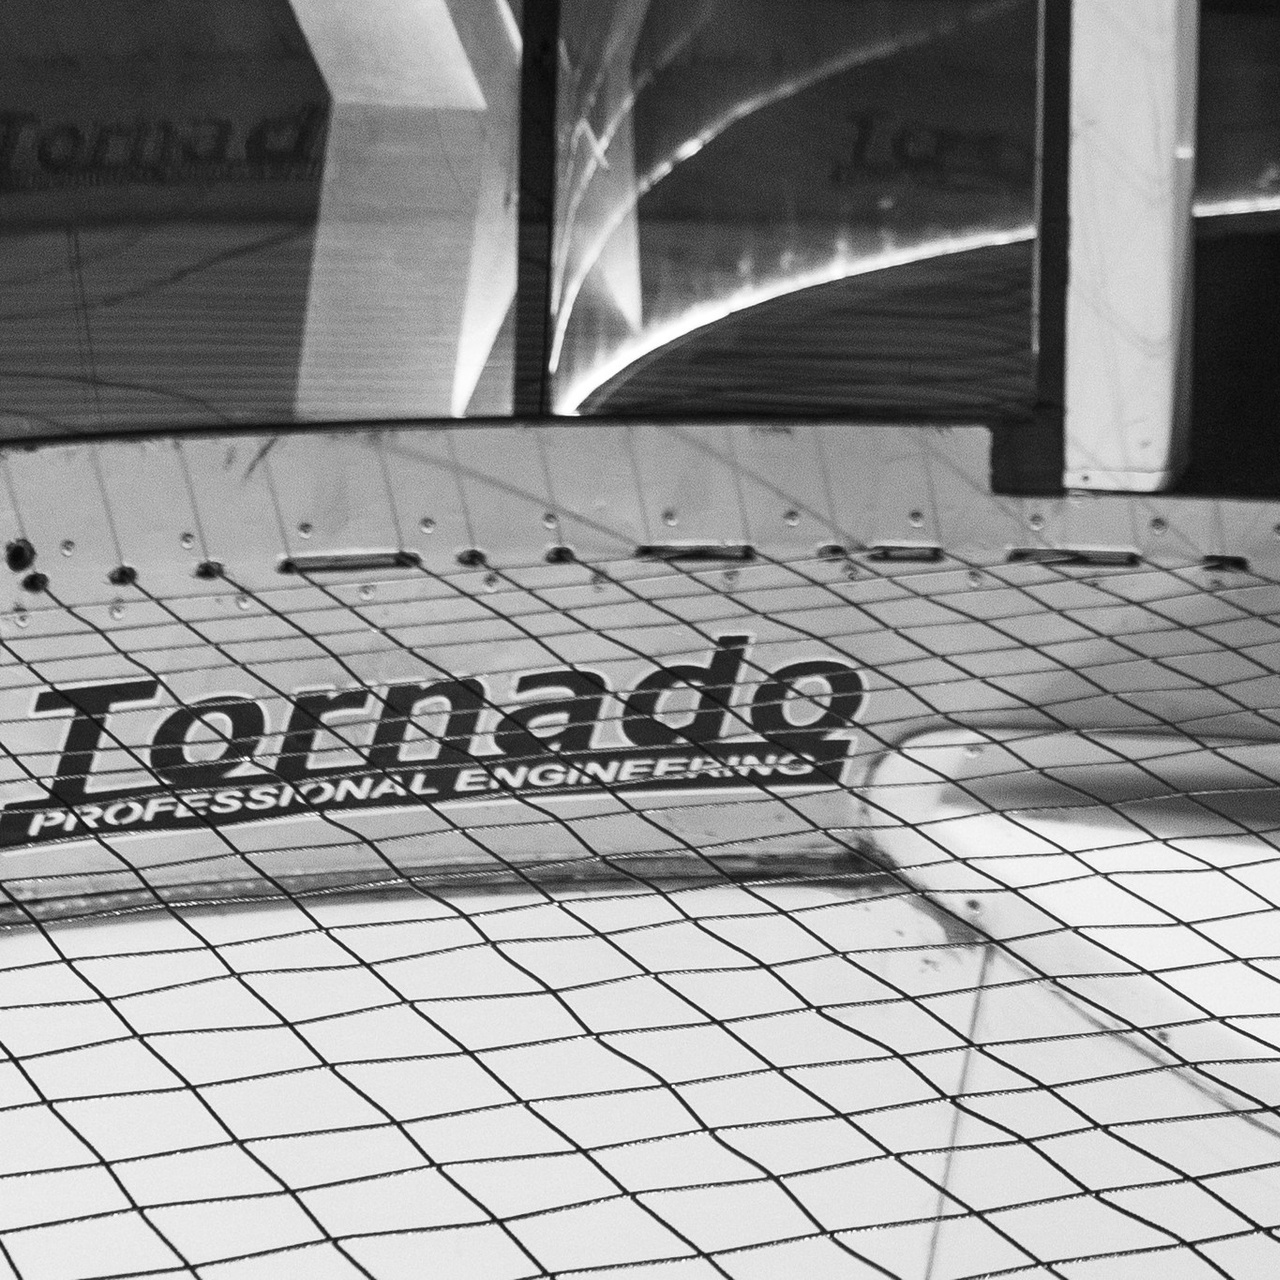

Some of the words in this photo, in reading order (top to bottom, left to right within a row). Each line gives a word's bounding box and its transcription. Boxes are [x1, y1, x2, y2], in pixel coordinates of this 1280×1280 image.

[0, 100, 330, 178] Tornad
[24, 634, 868, 804] Tornado
[26, 772, 440, 837] PROFESSIONAL
[453, 750, 819, 794] ENGINEERING
